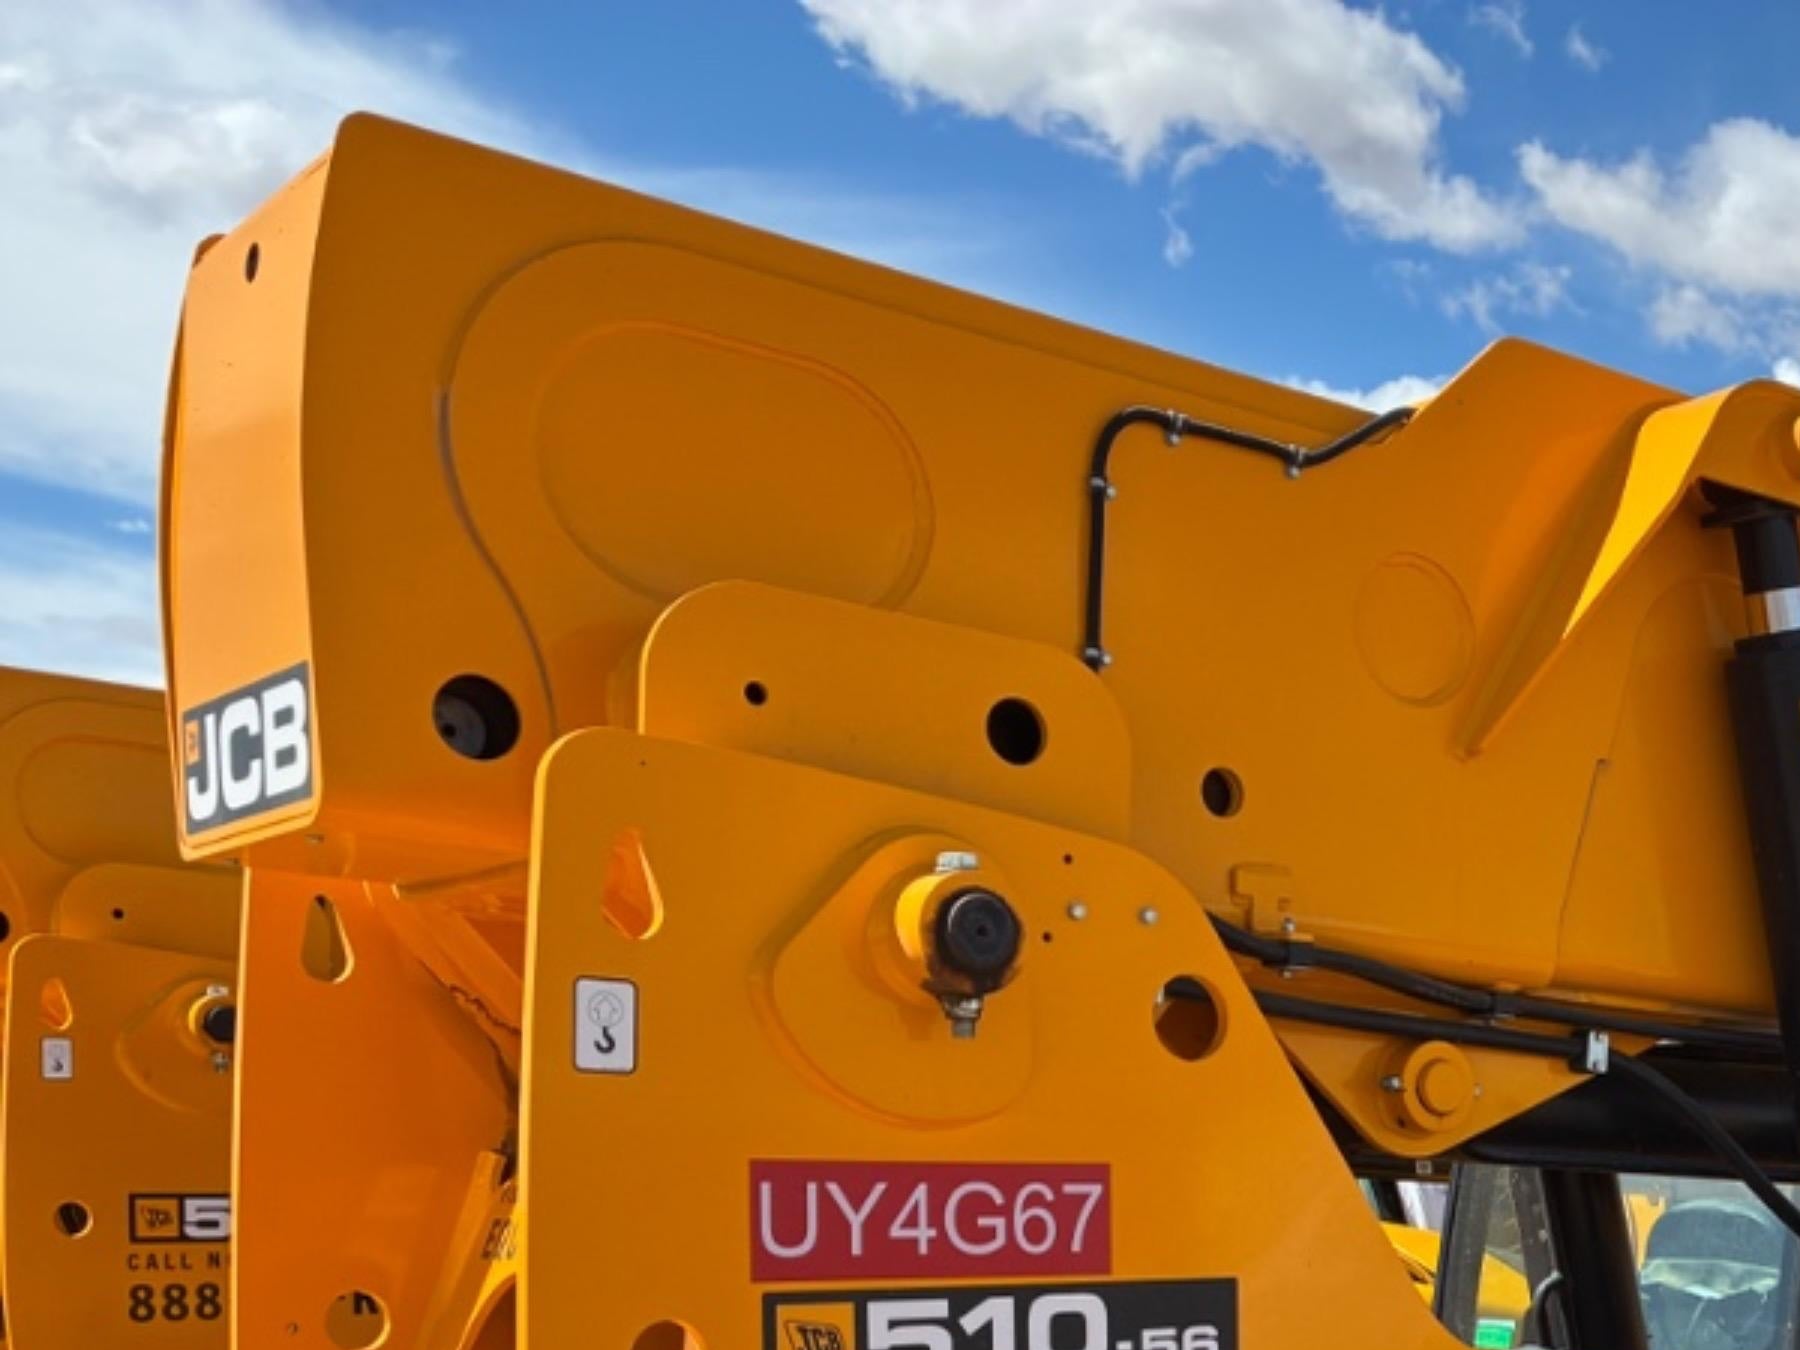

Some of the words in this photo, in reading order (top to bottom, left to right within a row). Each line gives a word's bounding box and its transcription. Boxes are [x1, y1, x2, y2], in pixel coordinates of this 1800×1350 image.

[187, 678, 309, 821] JCB
[757, 1180, 1105, 1260] UY4G67
[128, 1253, 193, 1271] CALL
